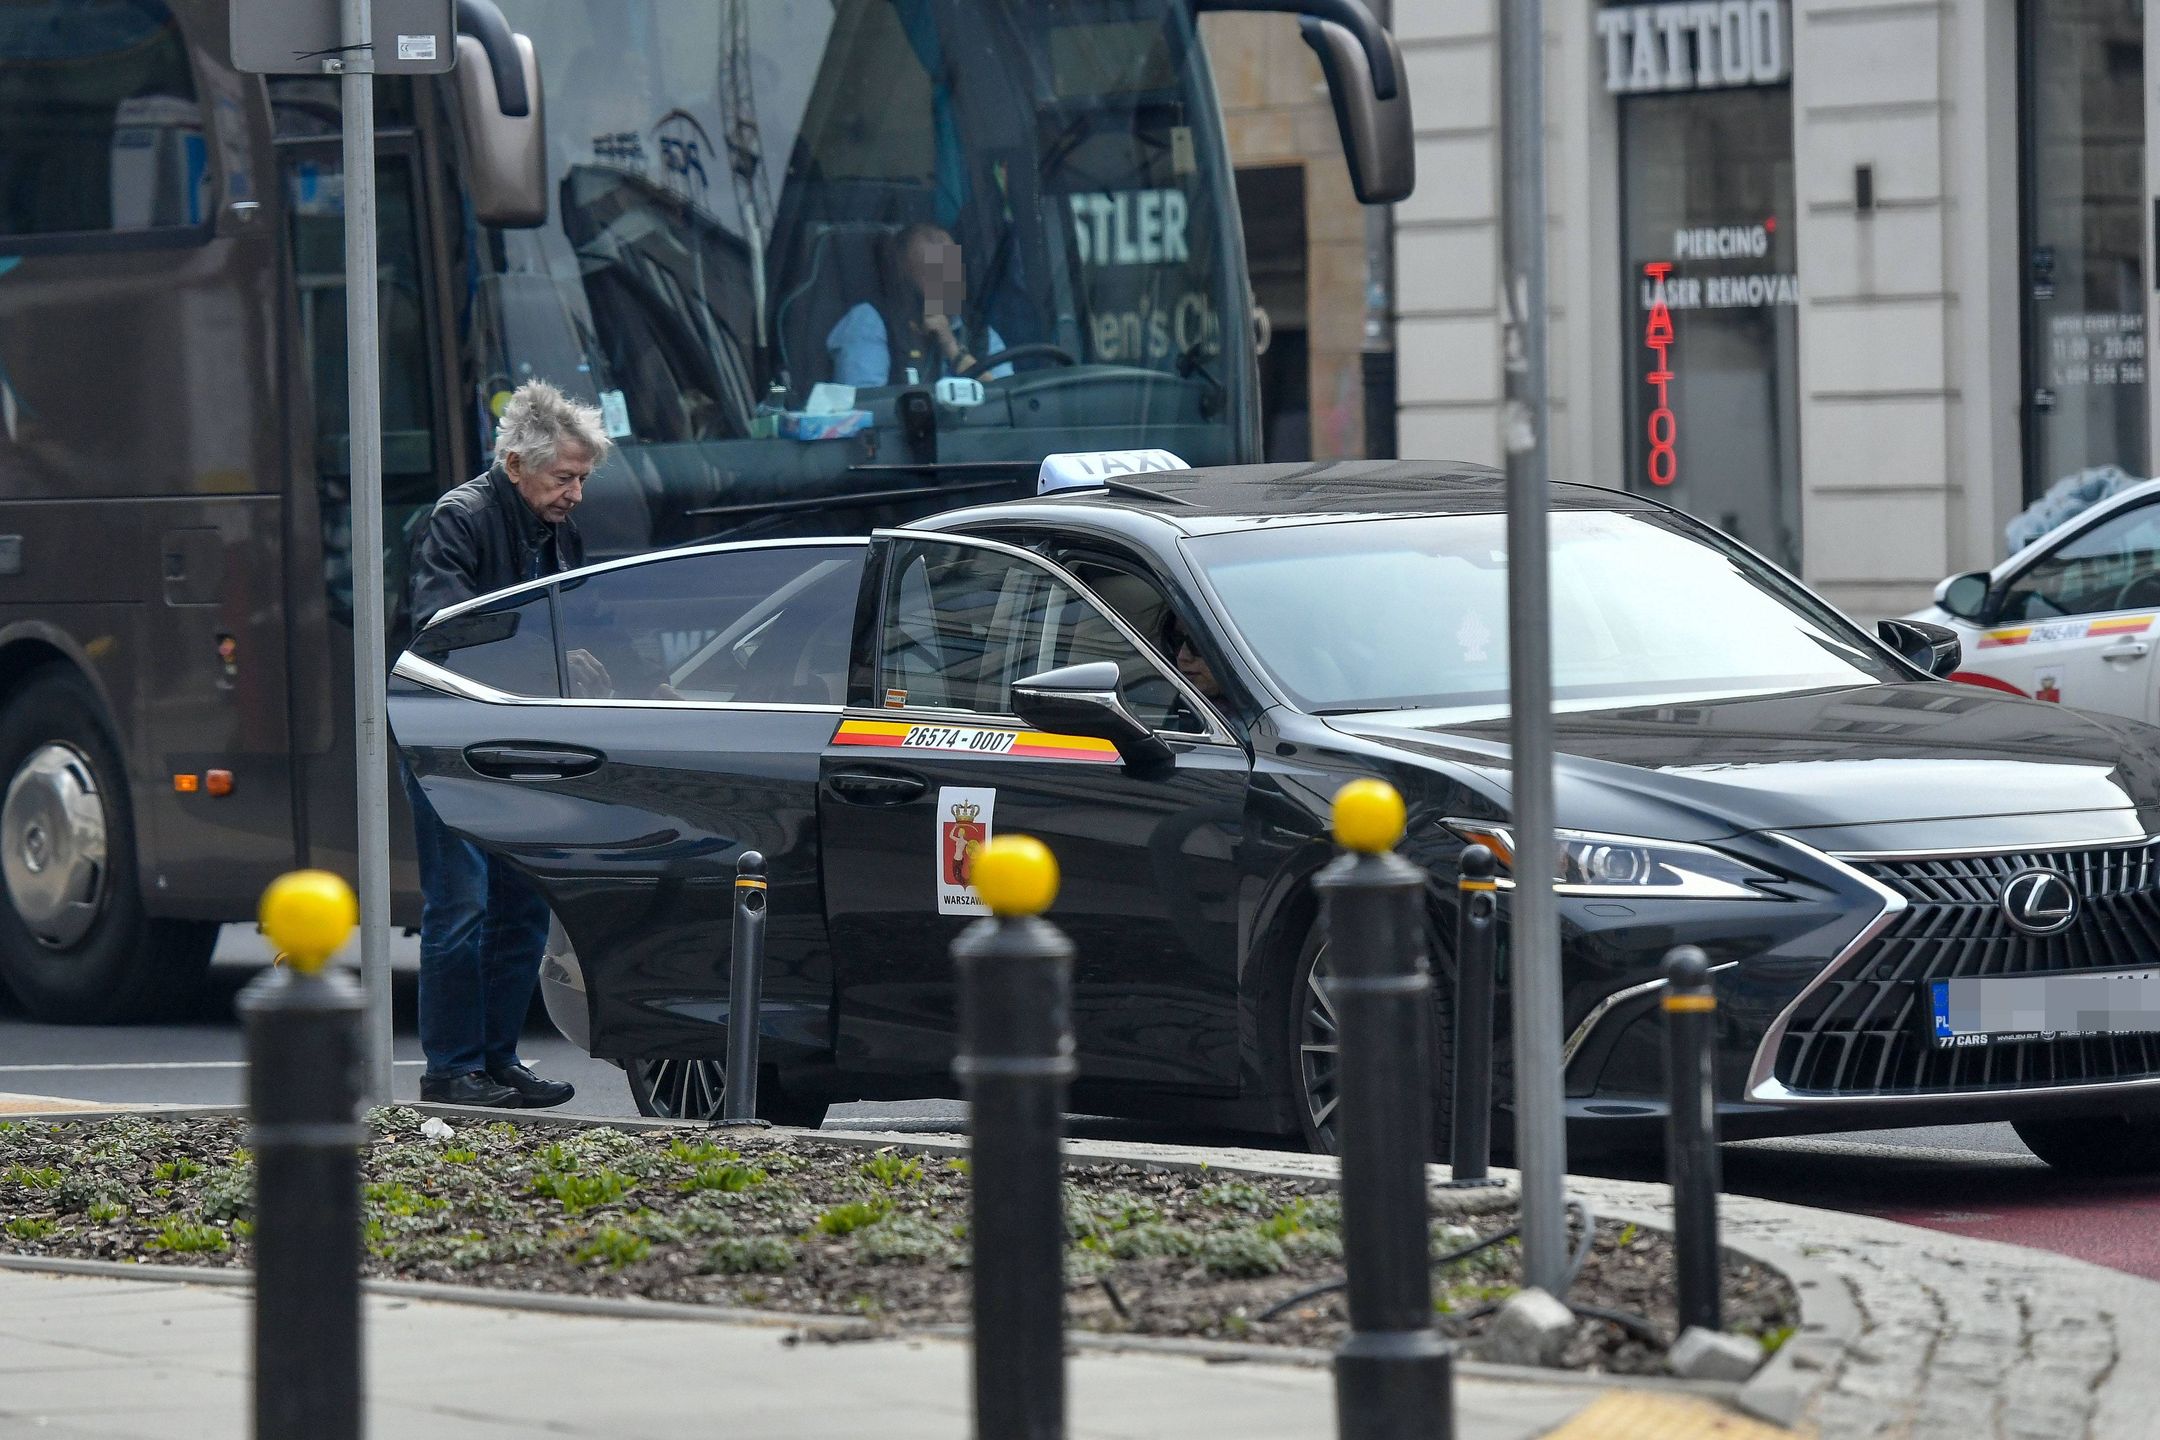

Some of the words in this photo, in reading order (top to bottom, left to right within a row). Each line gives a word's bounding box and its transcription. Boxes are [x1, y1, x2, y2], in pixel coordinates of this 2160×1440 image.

[1597, 1, 1781, 91] TATTOO
[1674, 225, 1767, 261] PIERCING
[1641, 277, 1699, 310] LASER
[1062, 451, 1178, 475] TAXI
[943, 895, 987, 906] WARSZAW
[1935, 1015, 1950, 1028] PL
[1940, 1036, 1955, 1048] 77
[1956, 1034, 1988, 1046] CARS
